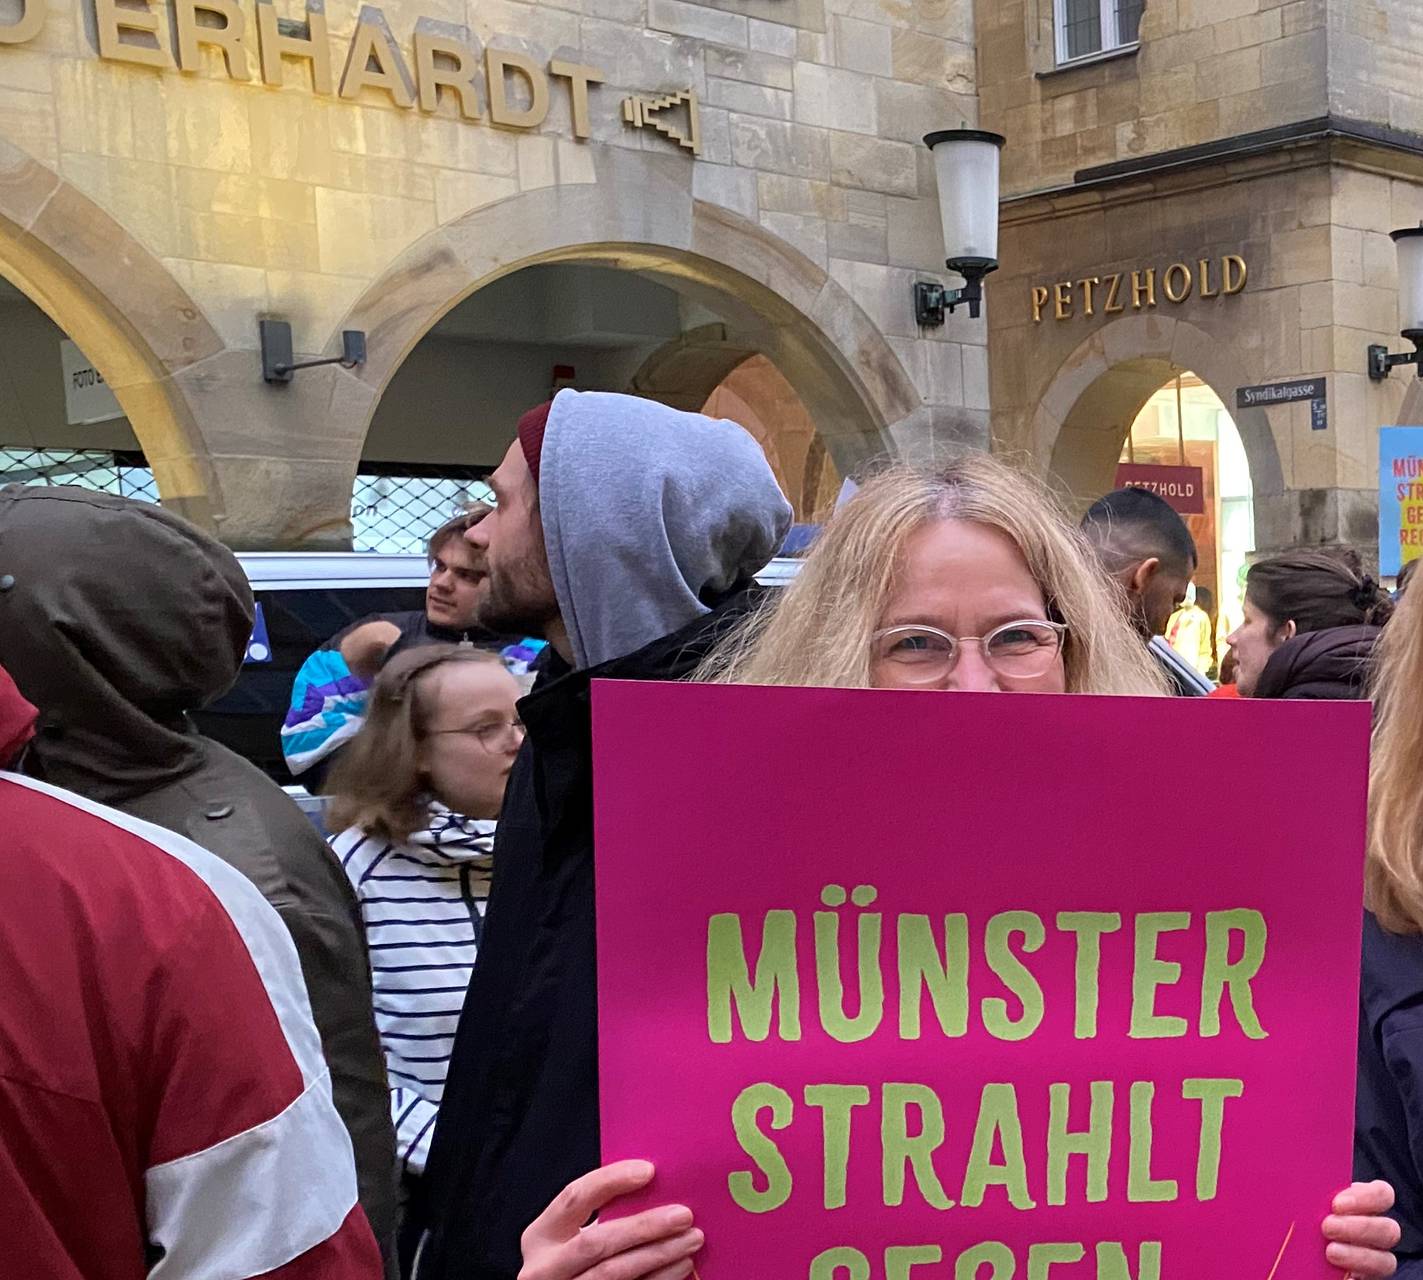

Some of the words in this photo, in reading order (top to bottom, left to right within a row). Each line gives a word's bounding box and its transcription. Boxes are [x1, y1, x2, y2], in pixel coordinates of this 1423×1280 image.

[97, 0, 606, 140] ERHARDT
[1031, 255, 1249, 322] PETZHOLD
[706, 884, 1269, 1043] MÜNSTER
[727, 1078, 1244, 1213] STRAHLT
